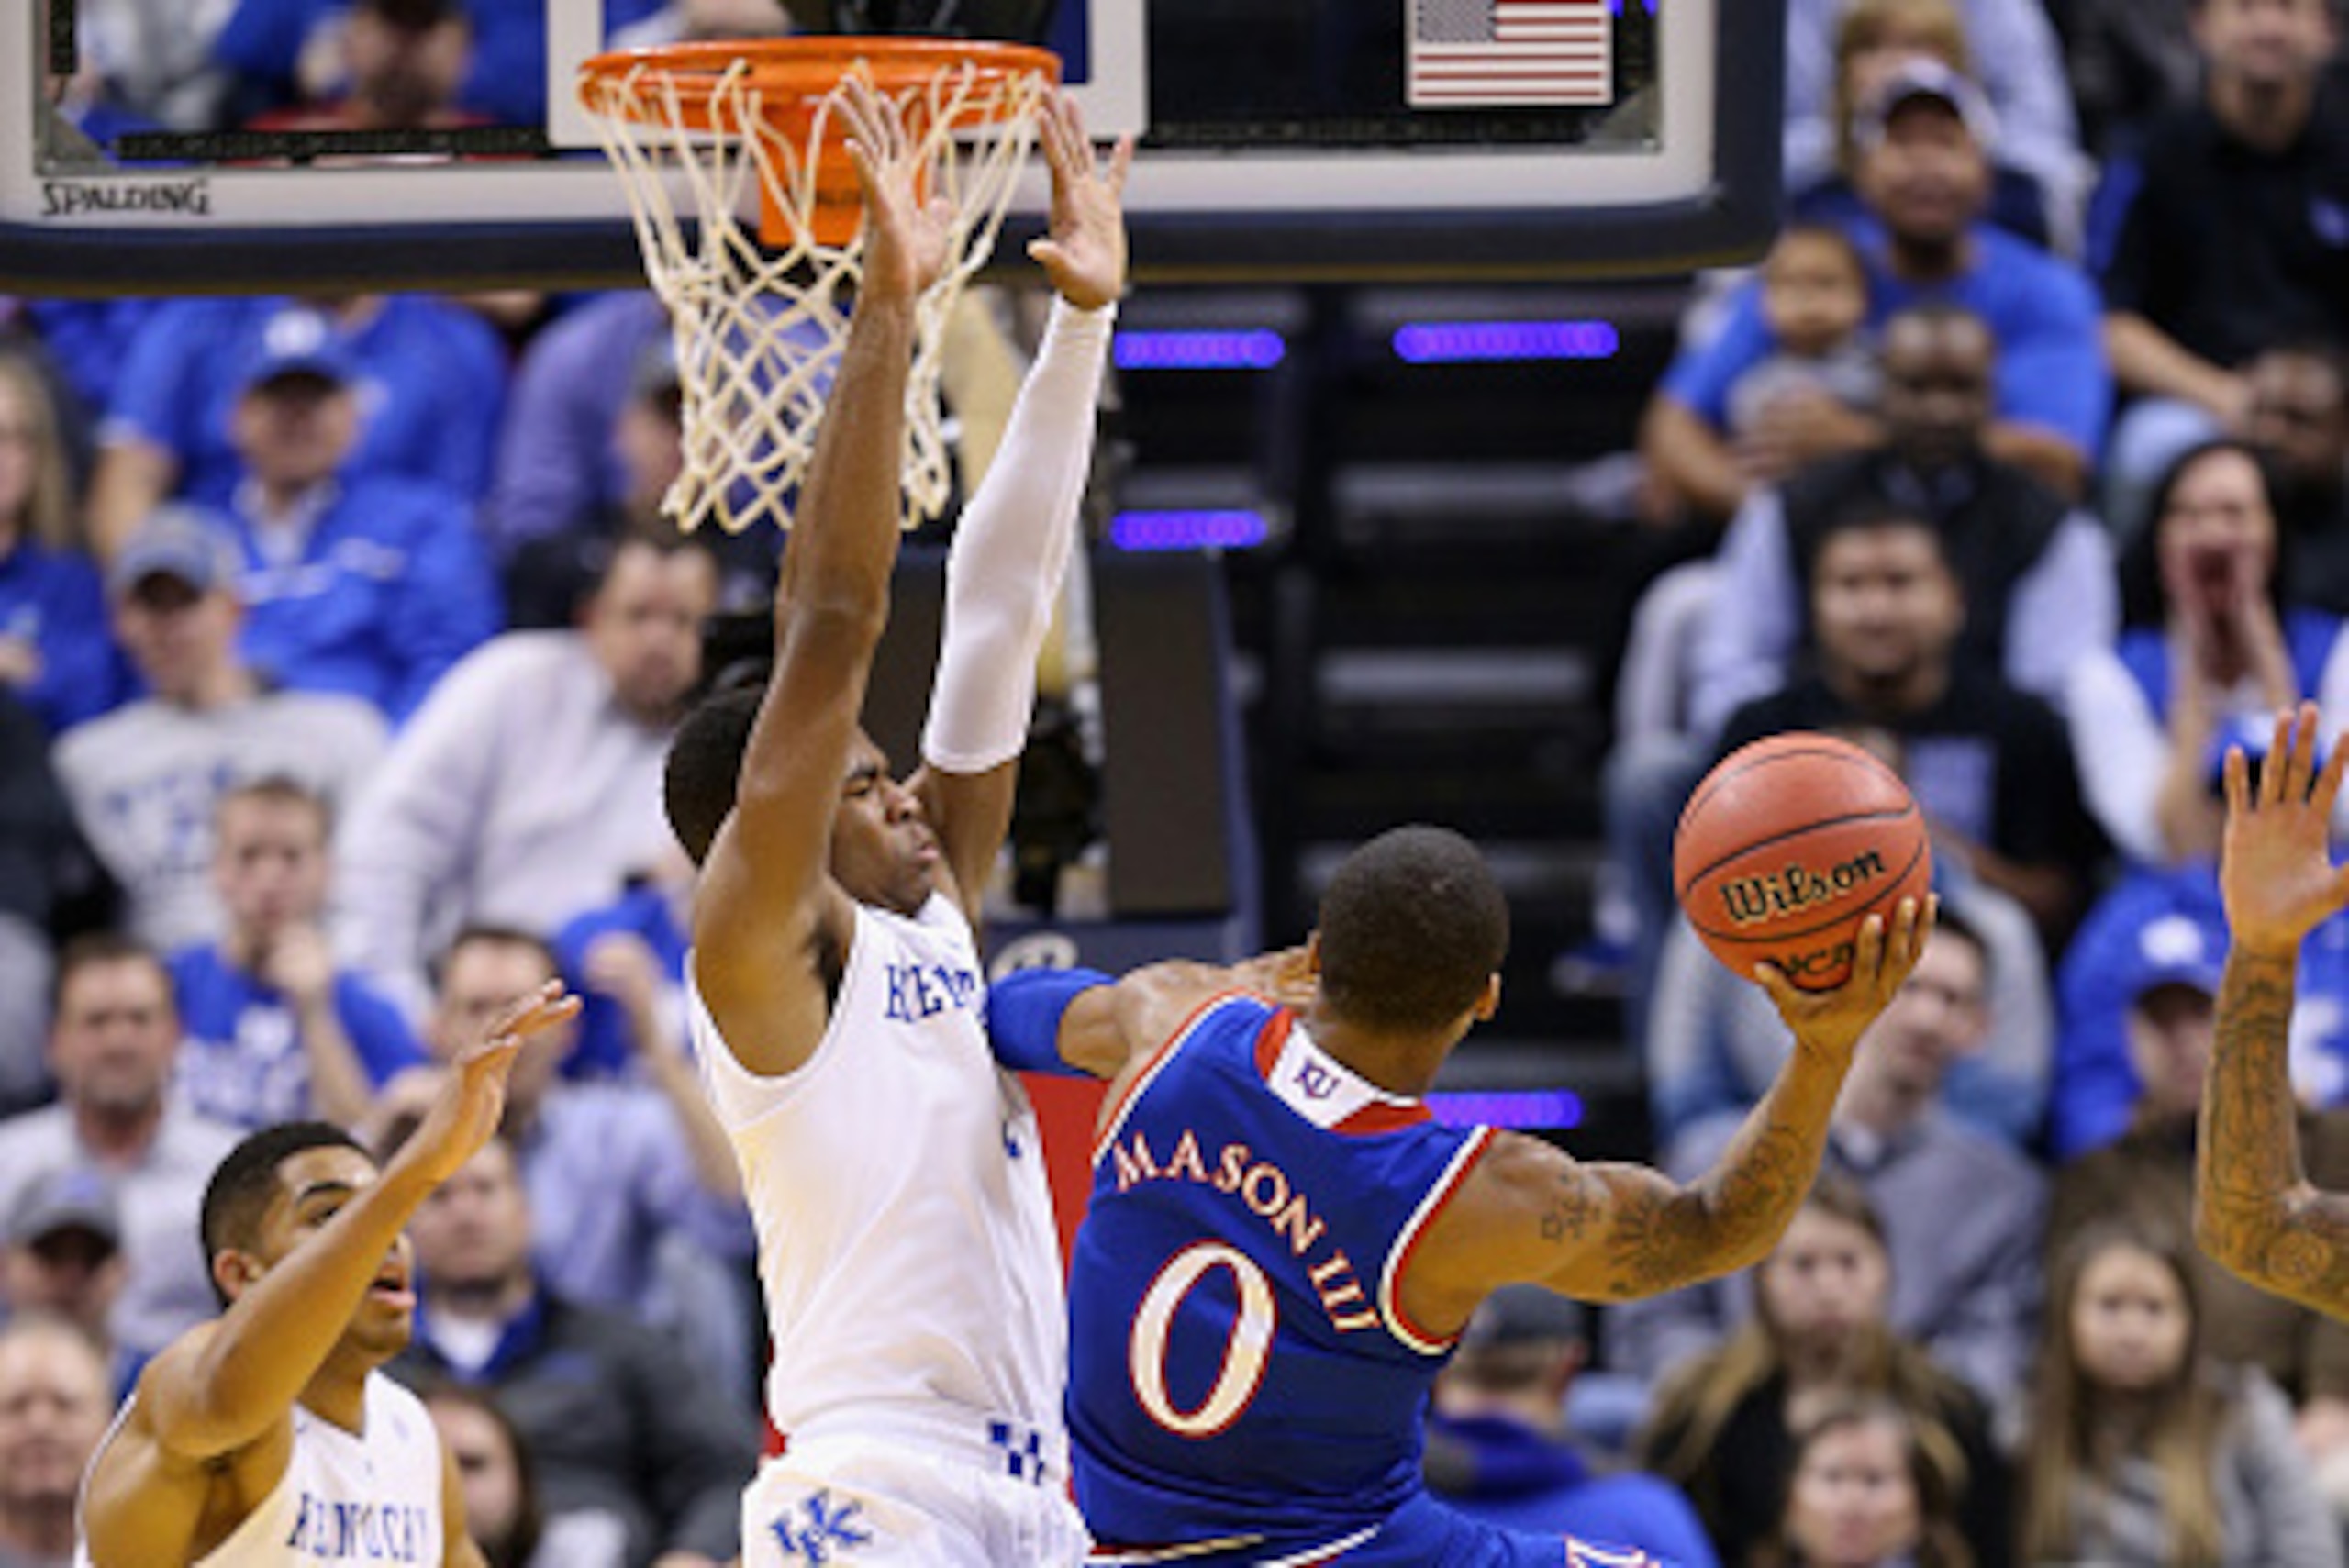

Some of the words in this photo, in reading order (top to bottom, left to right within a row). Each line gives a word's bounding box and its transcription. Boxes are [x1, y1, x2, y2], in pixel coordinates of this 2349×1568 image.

[41, 179, 212, 216] SPALDING
[1721, 849, 1885, 923] Wilson
[884, 964, 985, 1023] KENT
[1112, 1129, 1328, 1257] MASON
[1308, 1248, 1382, 1335] III
[1127, 1237, 1281, 1440] 0
